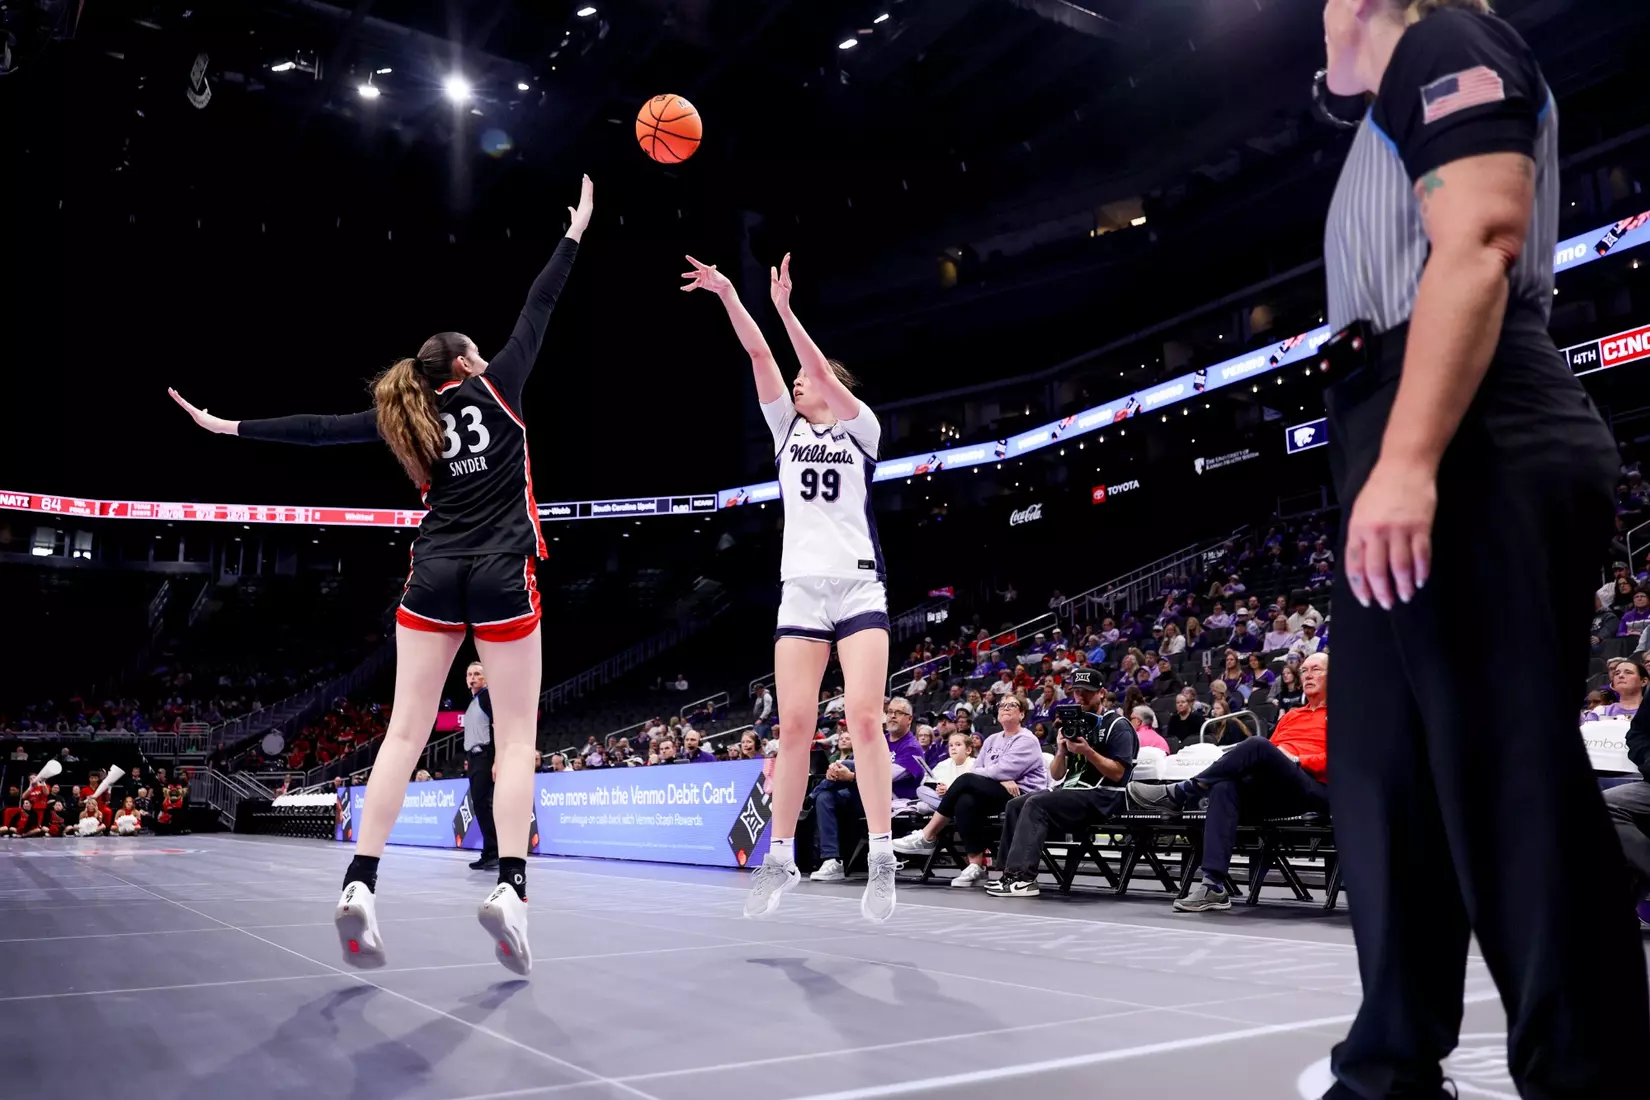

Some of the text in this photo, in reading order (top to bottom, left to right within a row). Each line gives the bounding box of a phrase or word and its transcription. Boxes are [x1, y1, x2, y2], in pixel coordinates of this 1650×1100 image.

[1554, 243, 1587, 265] mo
[1573, 349, 1597, 365] 4TH
[440, 405, 490, 459] 33
[790, 444, 854, 465] Wildcats
[449, 456, 488, 477] SNYDER
[800, 468, 841, 503] 99
[1107, 480, 1139, 495] TOYOTA
[540, 781, 737, 807] Score more with the Venmo Debit Card.
